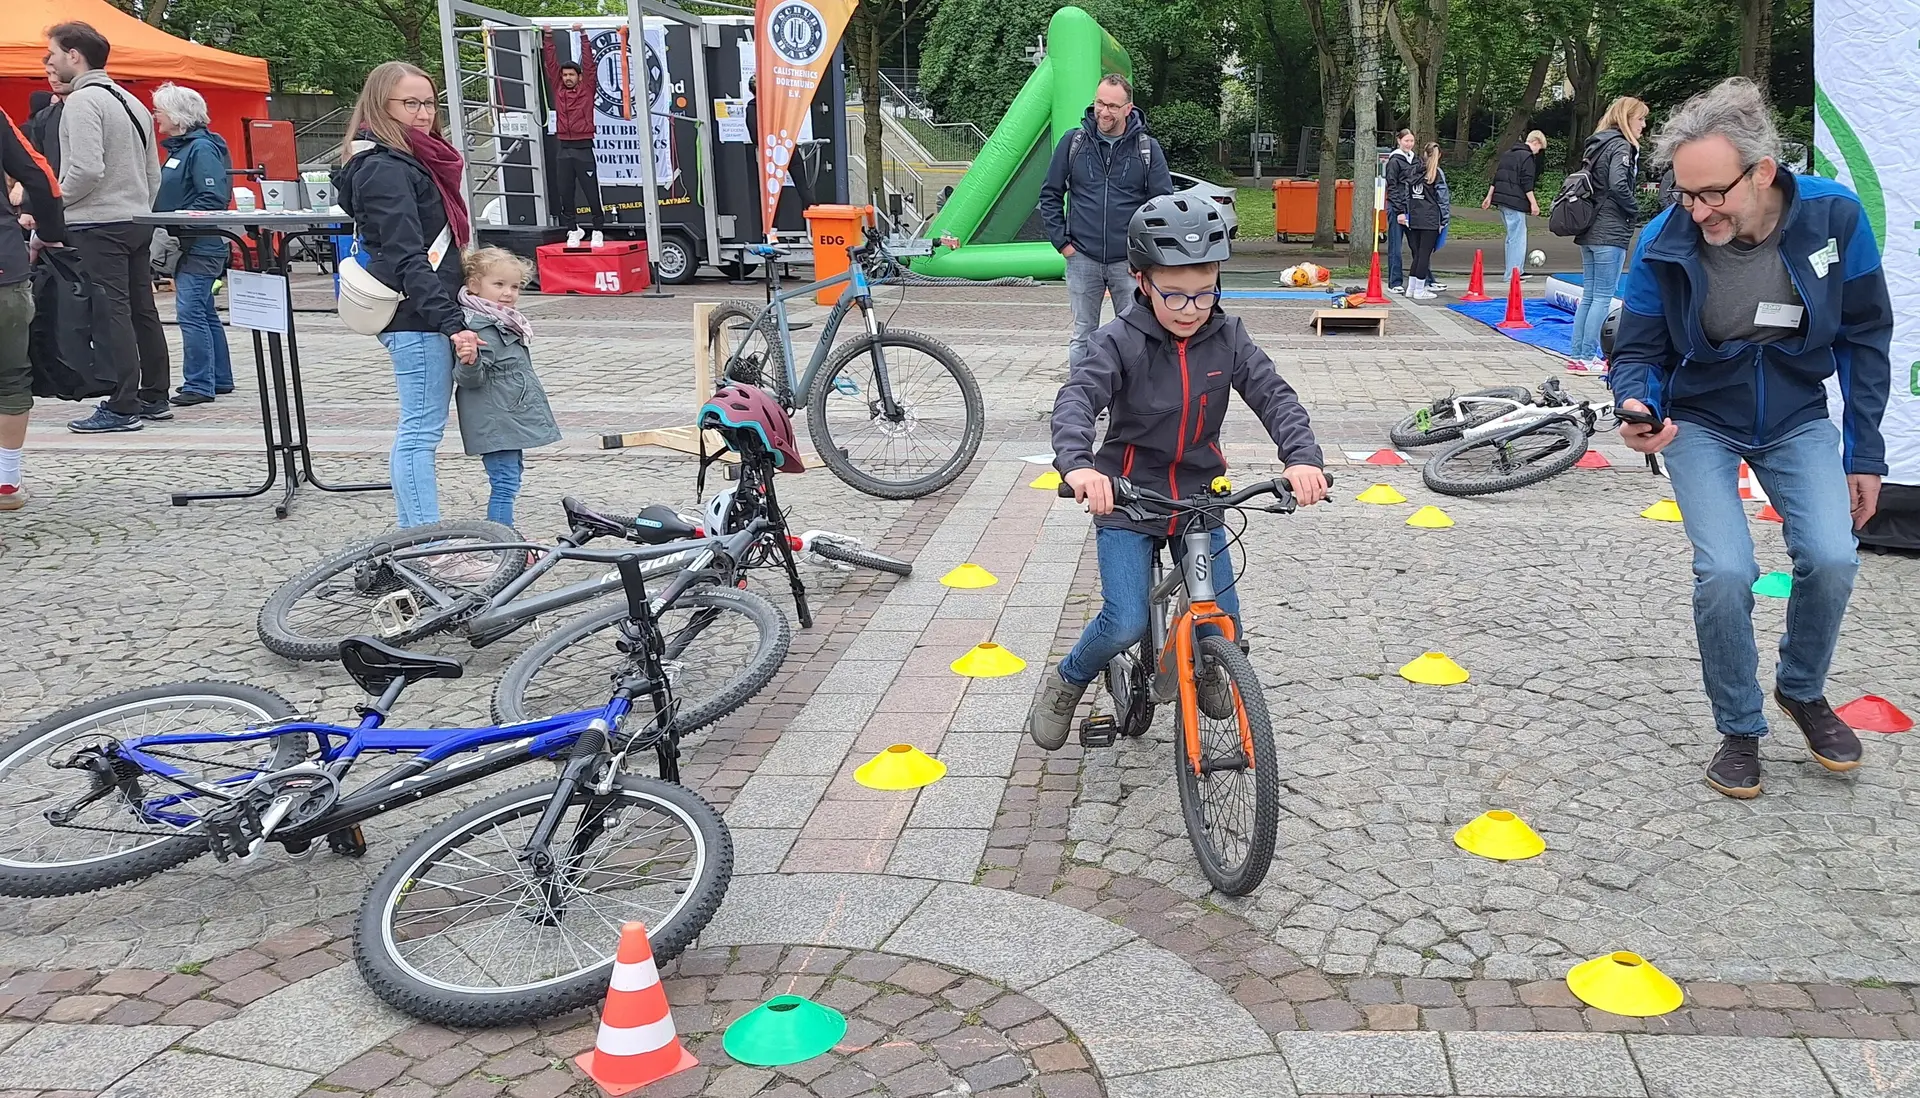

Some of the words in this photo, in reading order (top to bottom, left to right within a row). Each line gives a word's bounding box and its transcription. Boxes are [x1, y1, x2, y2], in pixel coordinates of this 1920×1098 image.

[773, 66, 818, 79] CALISTHENICS
[776, 77, 815, 89] DORTMUND
[788, 89, 801, 98] E.V.
[615, 169, 638, 179] E.V.
[576, 206, 592, 214] DEIN
[820, 235, 845, 246] EDG
[594, 271, 620, 292] 45
[600, 551, 687, 585] RDON
